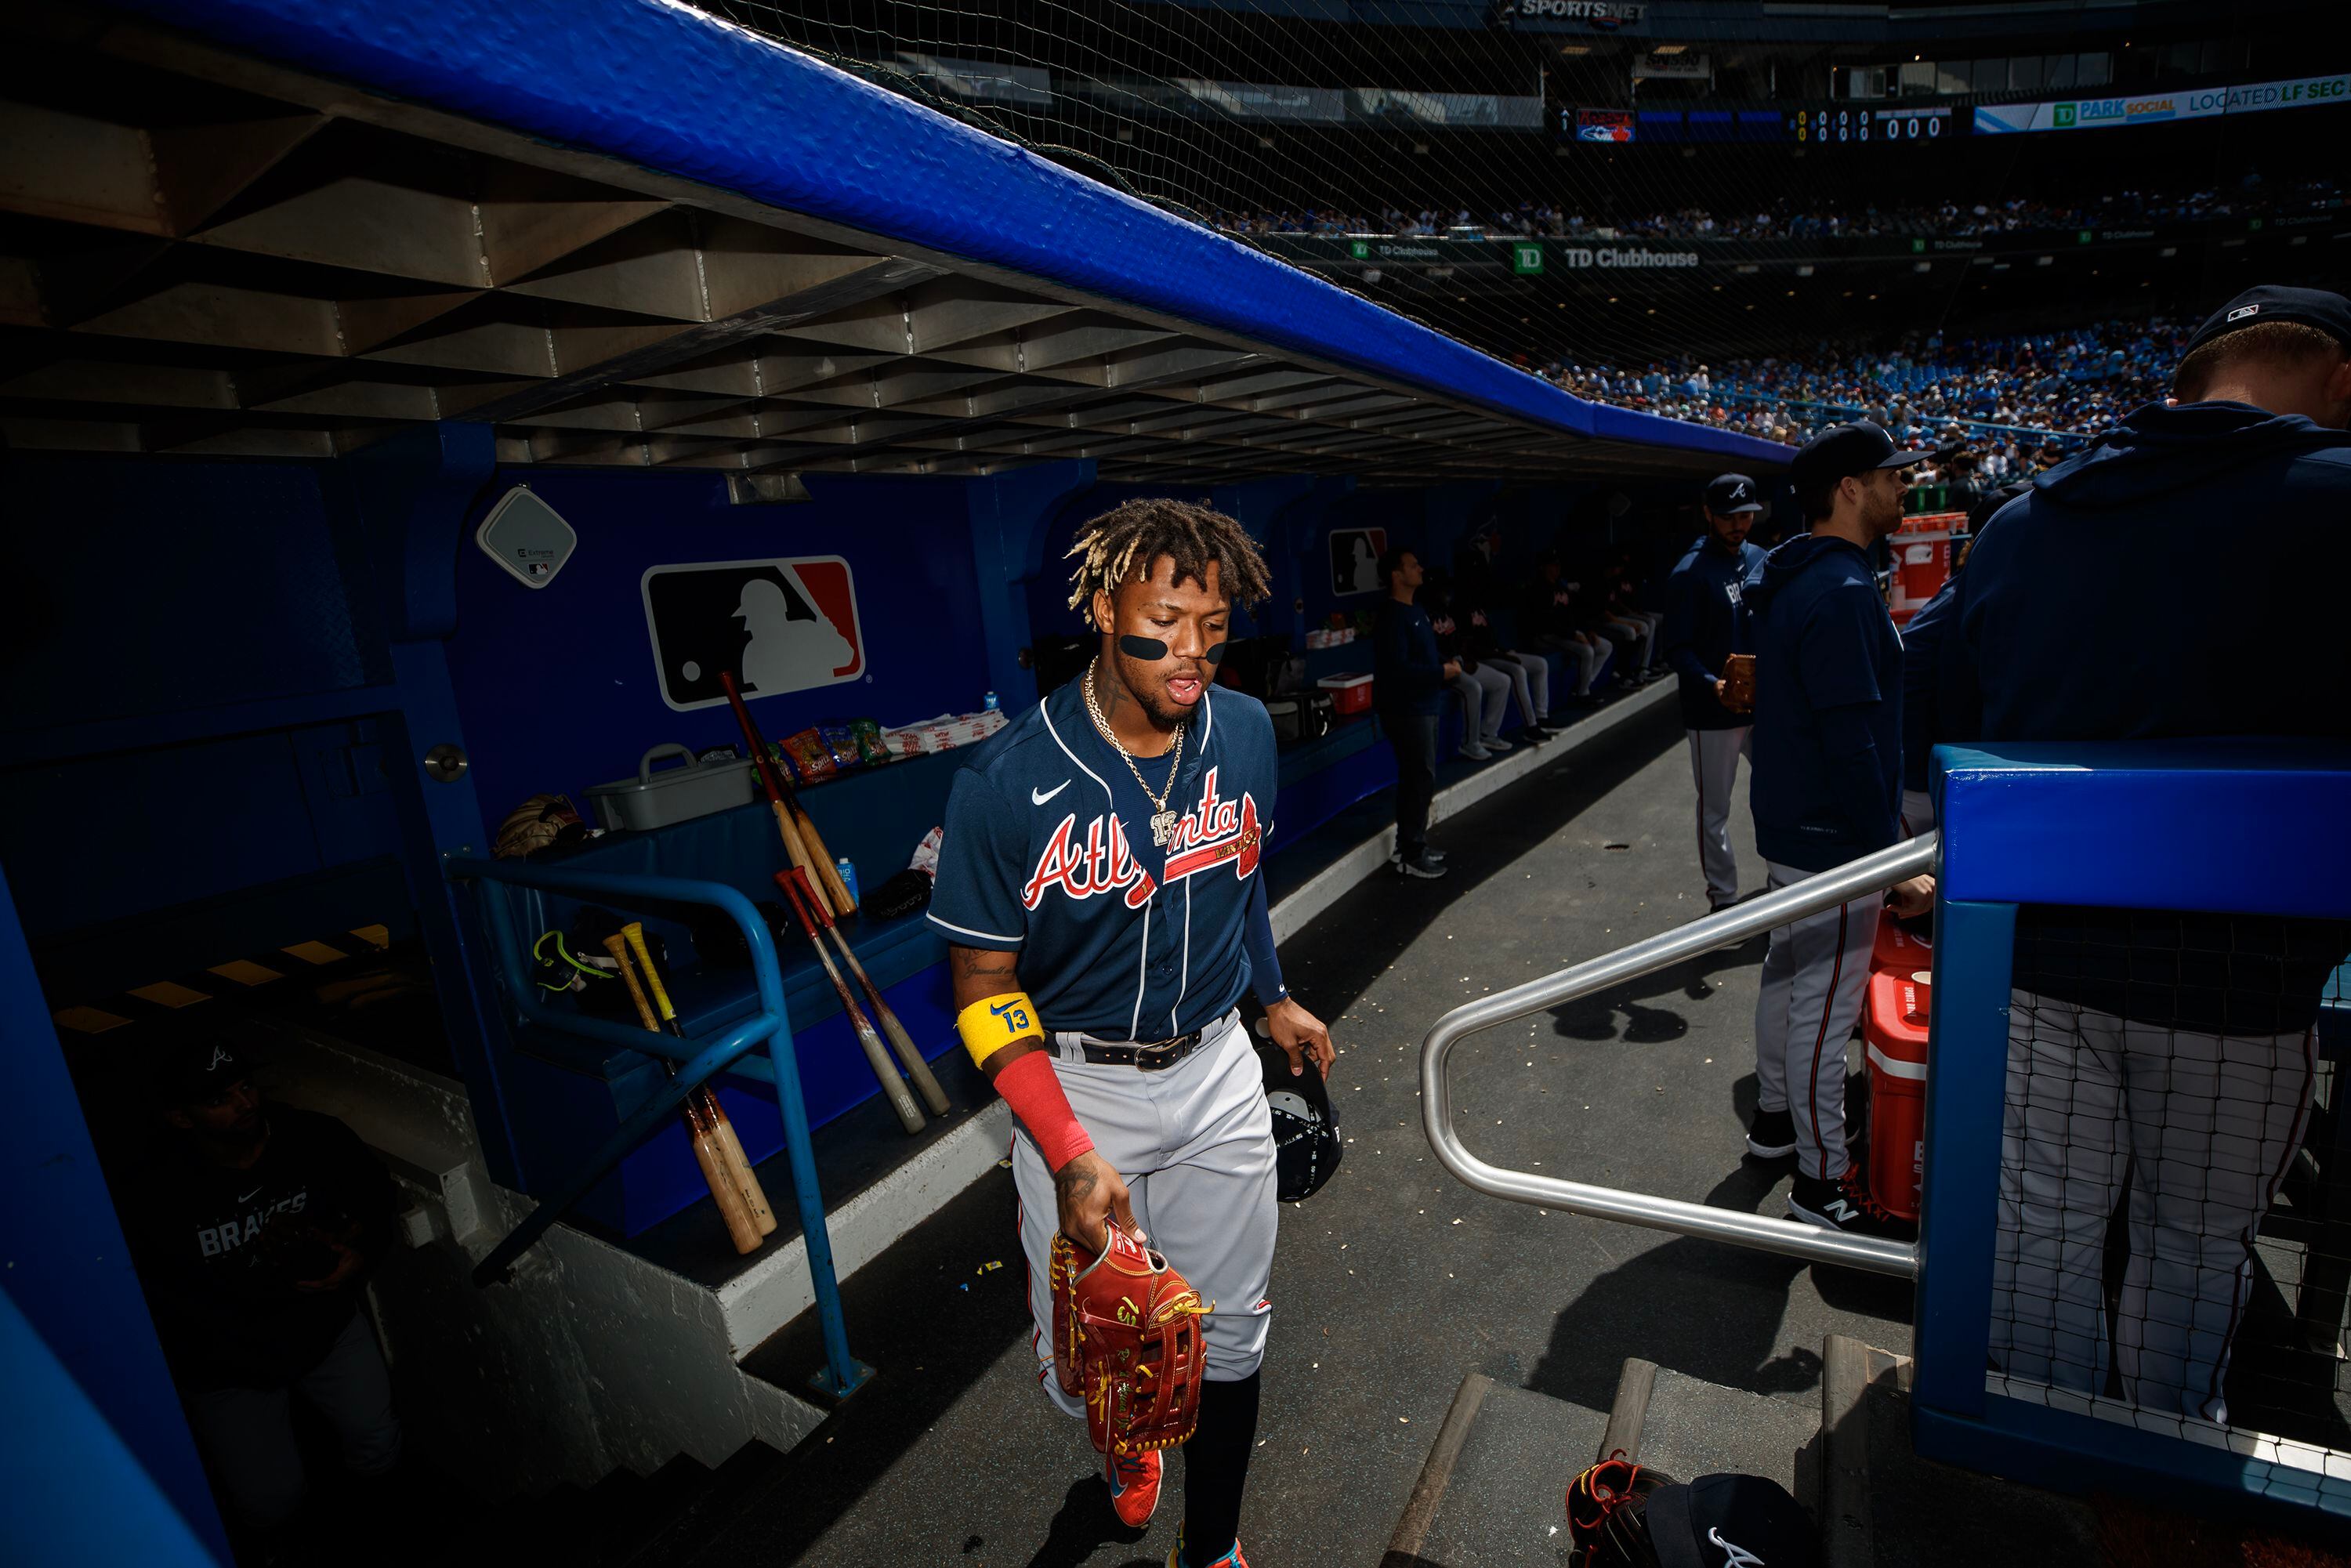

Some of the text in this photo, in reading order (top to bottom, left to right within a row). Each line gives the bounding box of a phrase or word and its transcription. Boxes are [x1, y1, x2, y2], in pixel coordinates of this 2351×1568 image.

[1521, 0, 1647, 20] SPORTSNET
[2190, 80, 2346, 111] LOCATED LF SEC
[2081, 100, 2126, 116] PARK
[2126, 100, 2175, 114] SOCIAL
[1888, 116, 1940, 139] 0 0 0
[1519, 248, 1541, 268] TD
[1566, 248, 1699, 267] TD Clubhouse
[1003, 1009, 1030, 1033] 13
